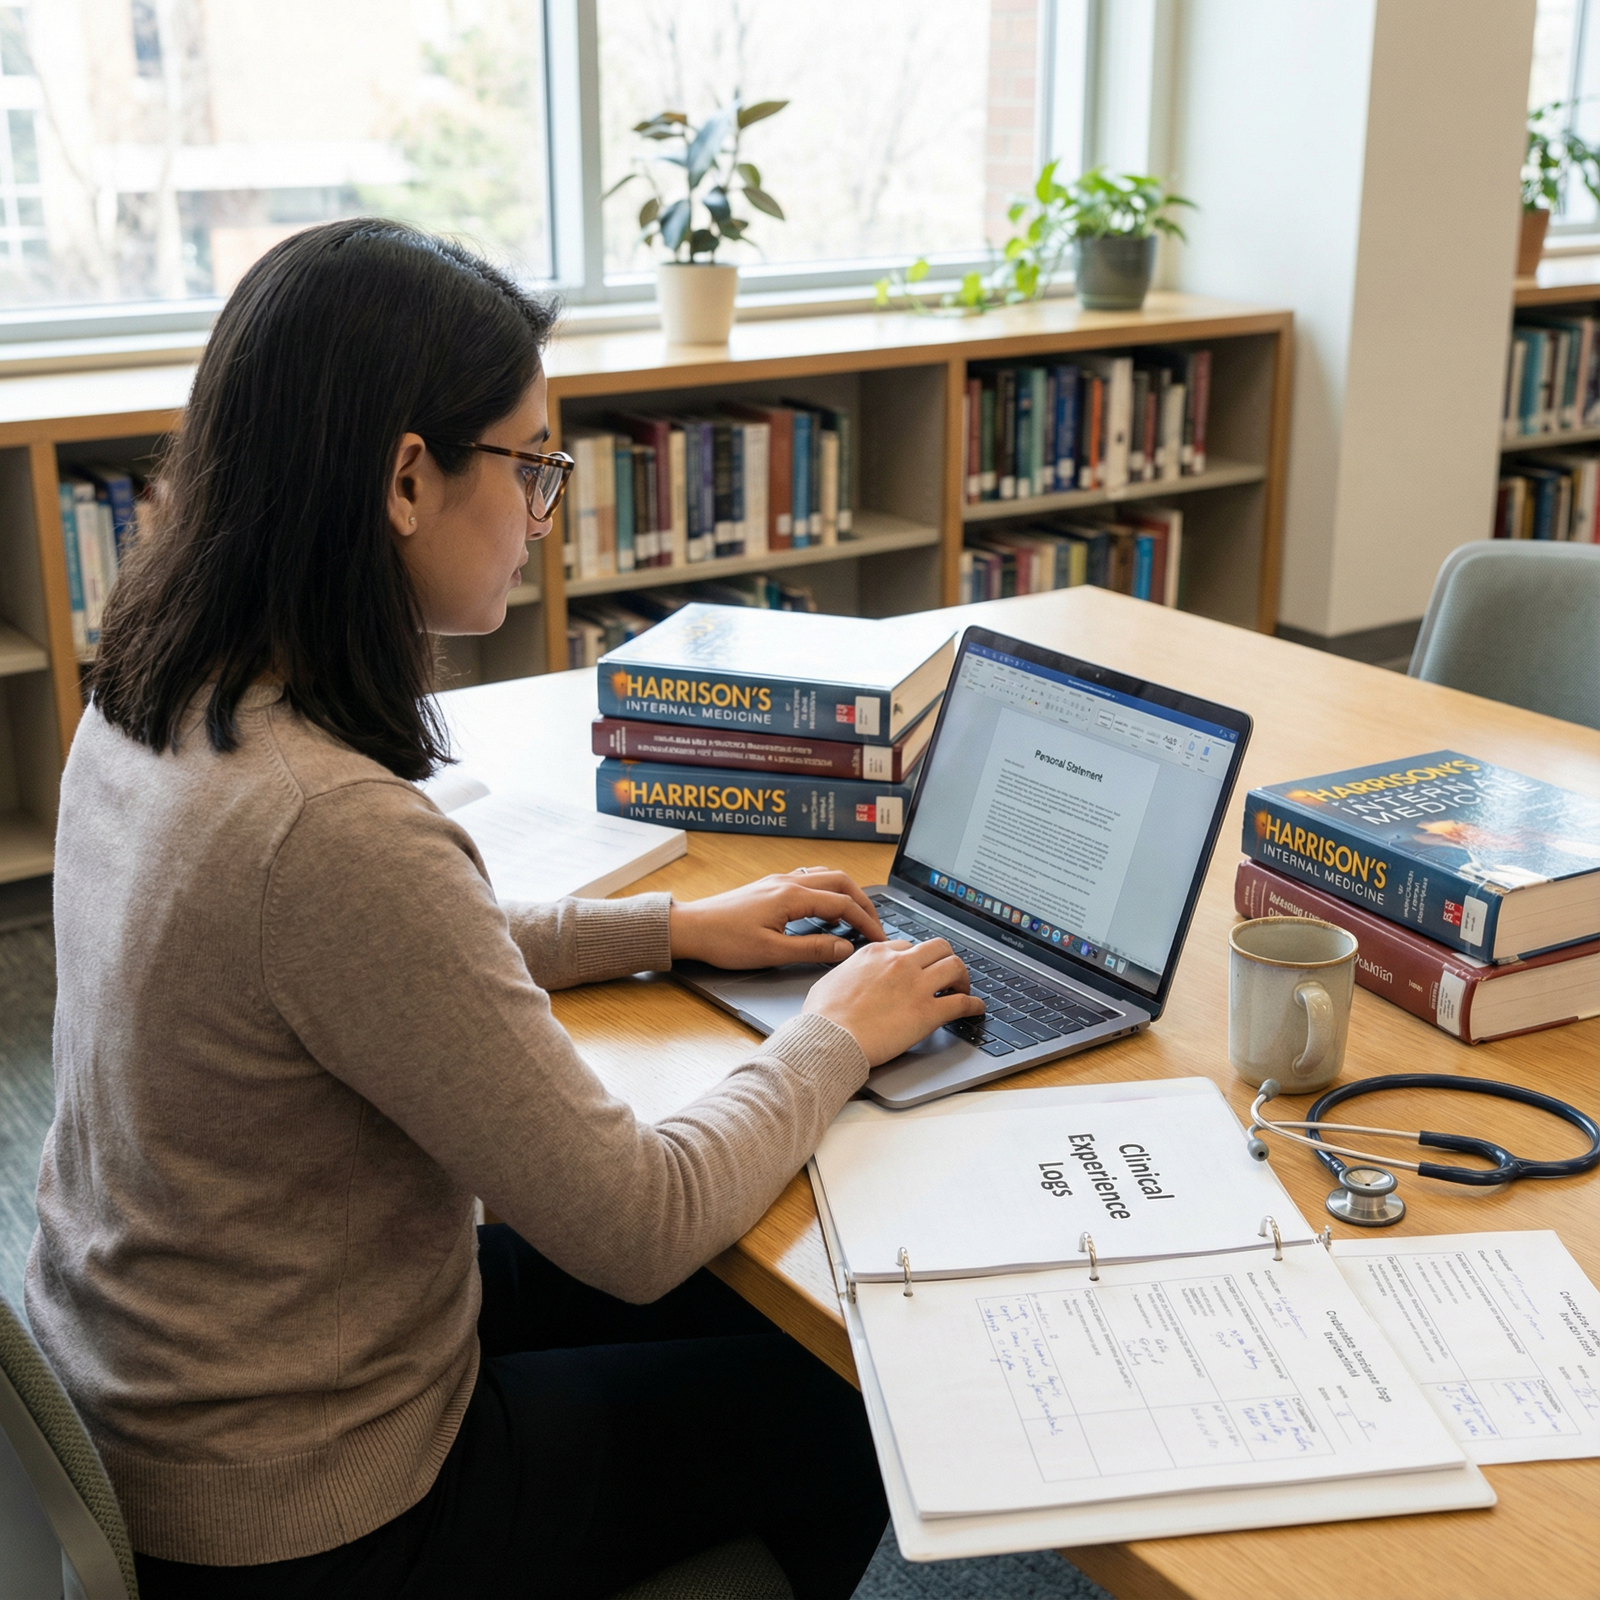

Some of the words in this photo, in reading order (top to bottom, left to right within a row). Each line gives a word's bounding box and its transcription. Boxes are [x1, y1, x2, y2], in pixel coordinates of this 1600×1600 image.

[626, 700, 697, 717] INTERNAL
[702, 708, 772, 725] MEDICINE
[627, 674, 772, 712] HARRISON'S
[1034, 749, 1066, 769] Personal
[1066, 761, 1103, 782] Statement
[1305, 759, 1481, 802] HARRISON'S
[630, 780, 787, 813] HARRISON'S
[1341, 774, 1517, 816] INTERNAL
[1361, 779, 1541, 825] MEDICINE
[630, 807, 706, 822] INTERNAL
[711, 812, 788, 828] MEDICINE
[1265, 814, 1388, 890] HARRISON'S
[1263, 843, 1320, 878] INTERNAL
[1324, 870, 1385, 906] MEDICINE
[1038, 1161, 1074, 1198] Logs
[1067, 1133, 1132, 1220] Experience
[1118, 1142, 1175, 1201] Clinical
